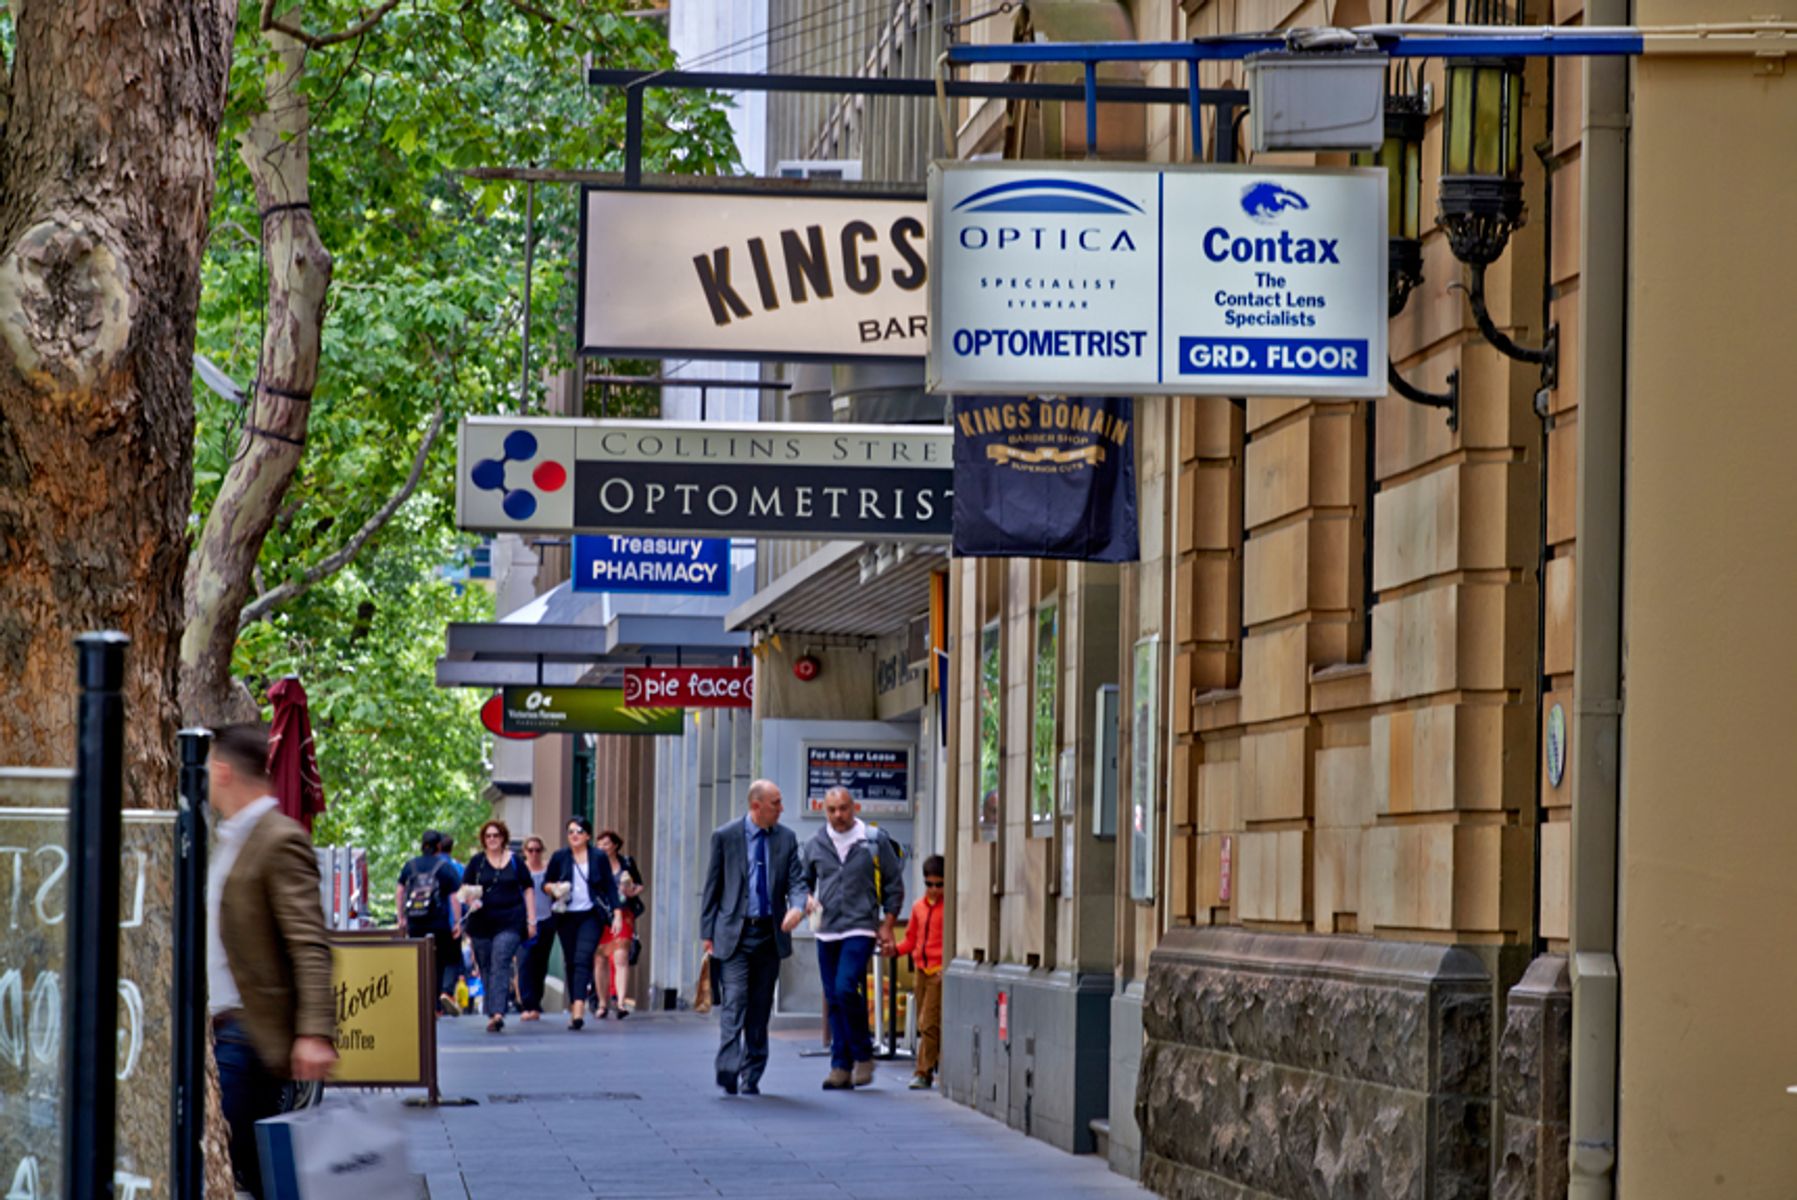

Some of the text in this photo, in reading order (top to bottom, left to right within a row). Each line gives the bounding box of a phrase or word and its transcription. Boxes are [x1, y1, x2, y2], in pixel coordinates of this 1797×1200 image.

[959, 226, 1137, 252] OPTICA
[1203, 226, 1340, 264] Contax
[693, 216, 927, 326] KINGS
[981, 277, 1117, 289] SPECIALIST
[1255, 272, 1286, 289] The
[1008, 300, 1089, 309] EYEWEAR
[1214, 290, 1326, 308] Contact Lens
[1224, 309, 1316, 328] Specialists
[953, 329, 1148, 357] OPTOMETRIST
[1189, 344, 1358, 370] GRD. FLOOR
[957, 403, 1129, 446] KINGS DOMAIN
[601, 432, 954, 463] COLLINS STRE
[608, 536, 702, 559] Treasury
[592, 560, 718, 582] PHARMACY
[645, 671, 742, 701] pie face
[810, 750, 827, 759] For
